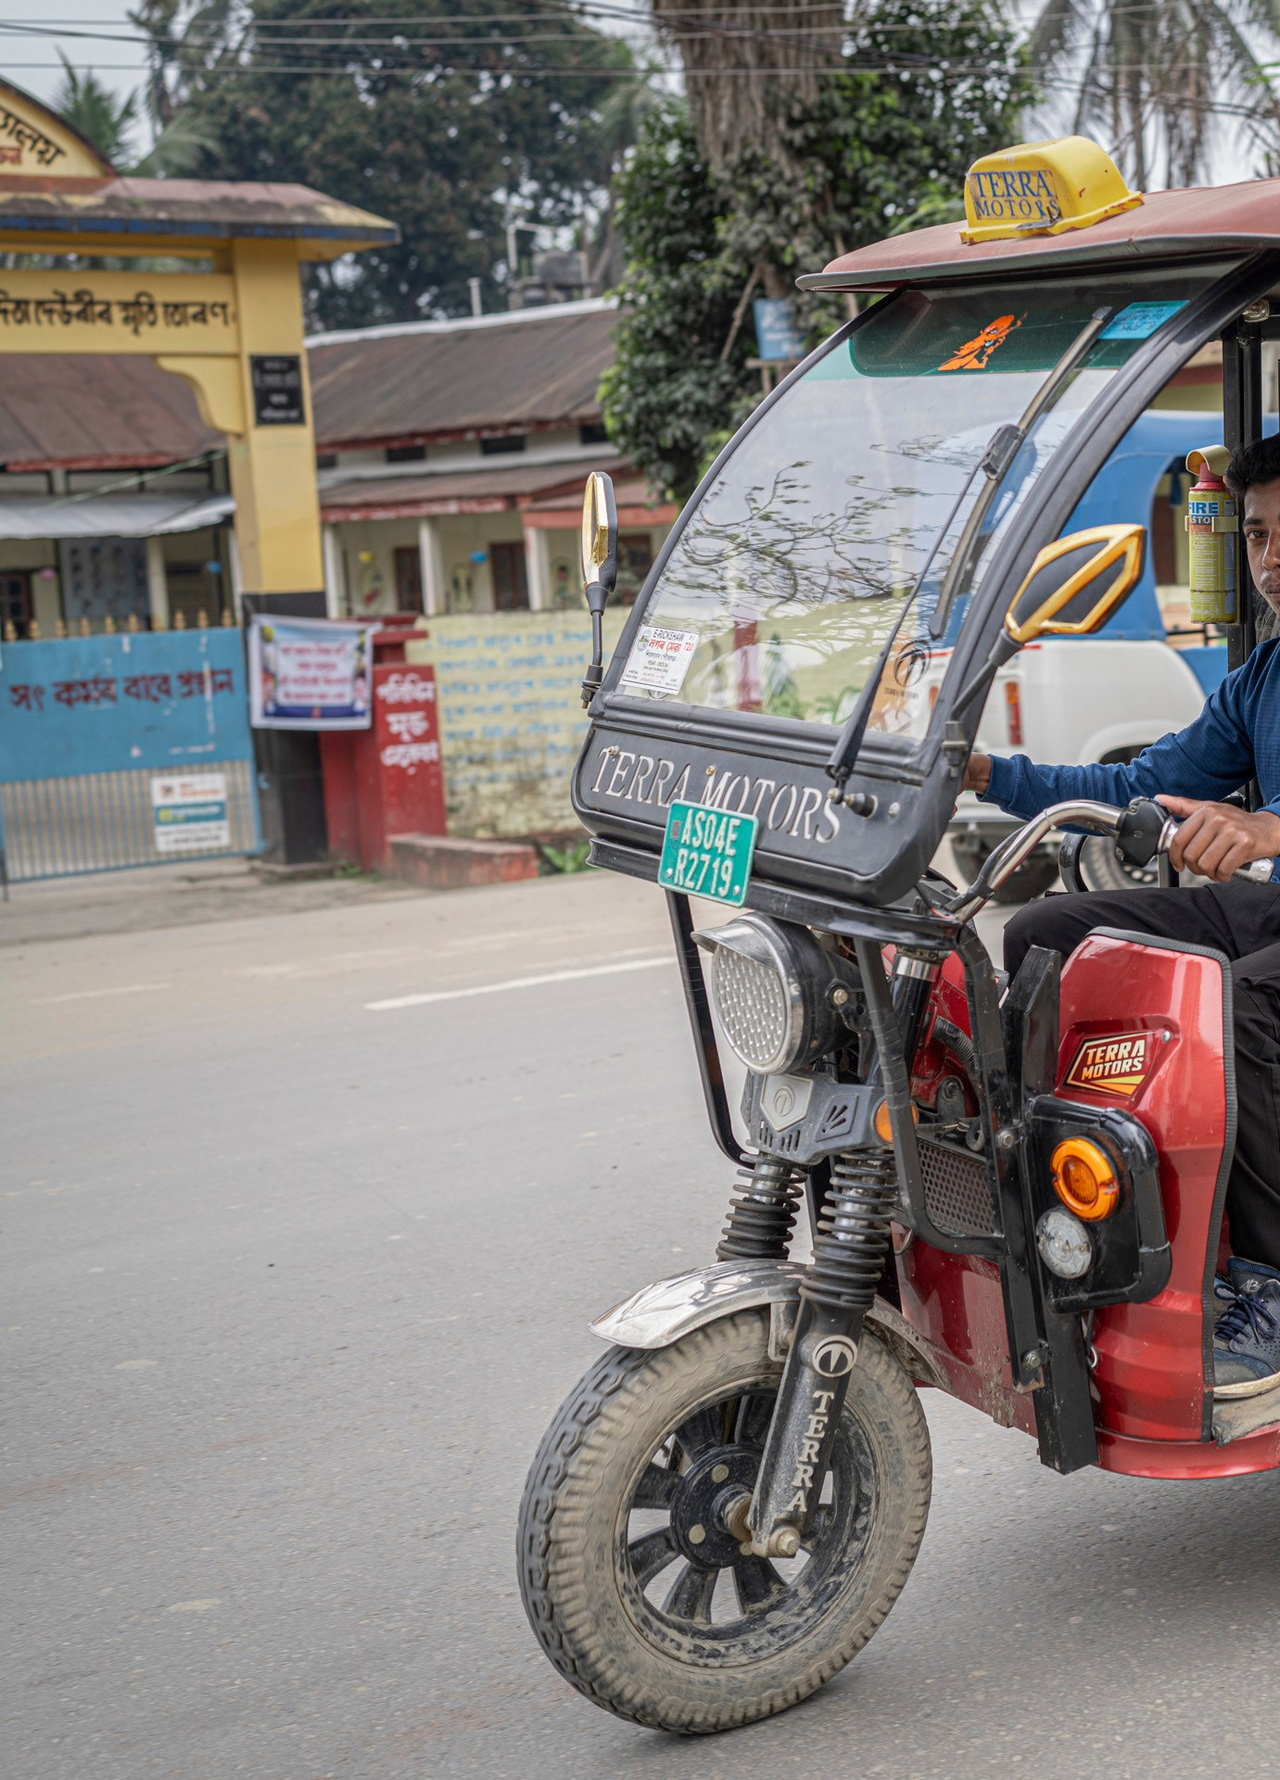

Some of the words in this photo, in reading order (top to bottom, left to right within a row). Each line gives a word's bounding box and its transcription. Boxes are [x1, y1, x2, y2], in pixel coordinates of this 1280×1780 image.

[970, 170, 1054, 198] TERRA
[975, 199, 1059, 218] MOTORS
[1192, 516, 1211, 524] STO
[590, 747, 692, 808] TERRA
[699, 771, 842, 844] MOTORS
[680, 808, 741, 856] AS04E
[673, 849, 734, 898] R2719
[1086, 1039, 1146, 1066] TERRA
[1081, 1057, 1145, 1081] MOTORS
[786, 1390, 835, 1513] TERRA
